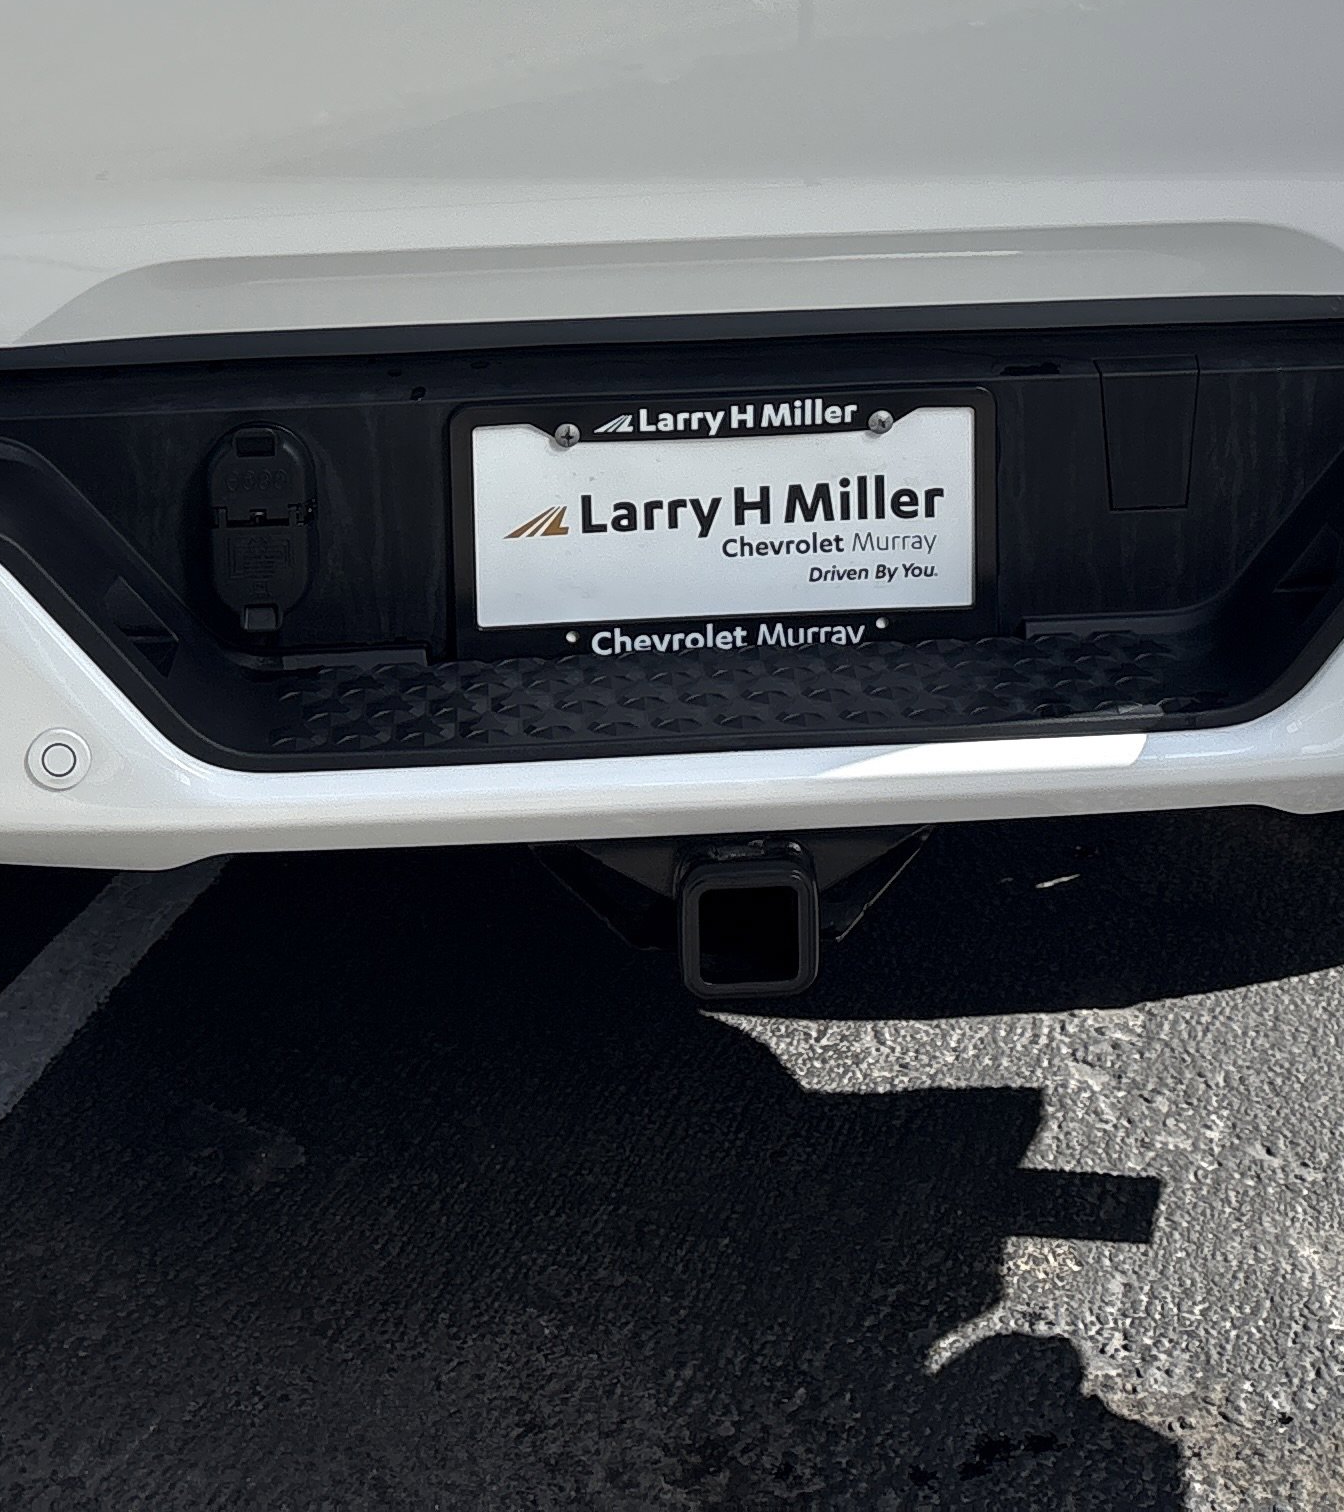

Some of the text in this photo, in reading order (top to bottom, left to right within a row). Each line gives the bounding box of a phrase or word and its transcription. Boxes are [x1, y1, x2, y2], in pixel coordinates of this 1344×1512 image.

[639, 398, 858, 436] Larry H Miller
[580, 474, 945, 539] Larry H Miller
[721, 531, 937, 558] Chevrolet Murray
[808, 562, 939, 583] Driven By You.
[591, 623, 748, 656] Chevrolet
